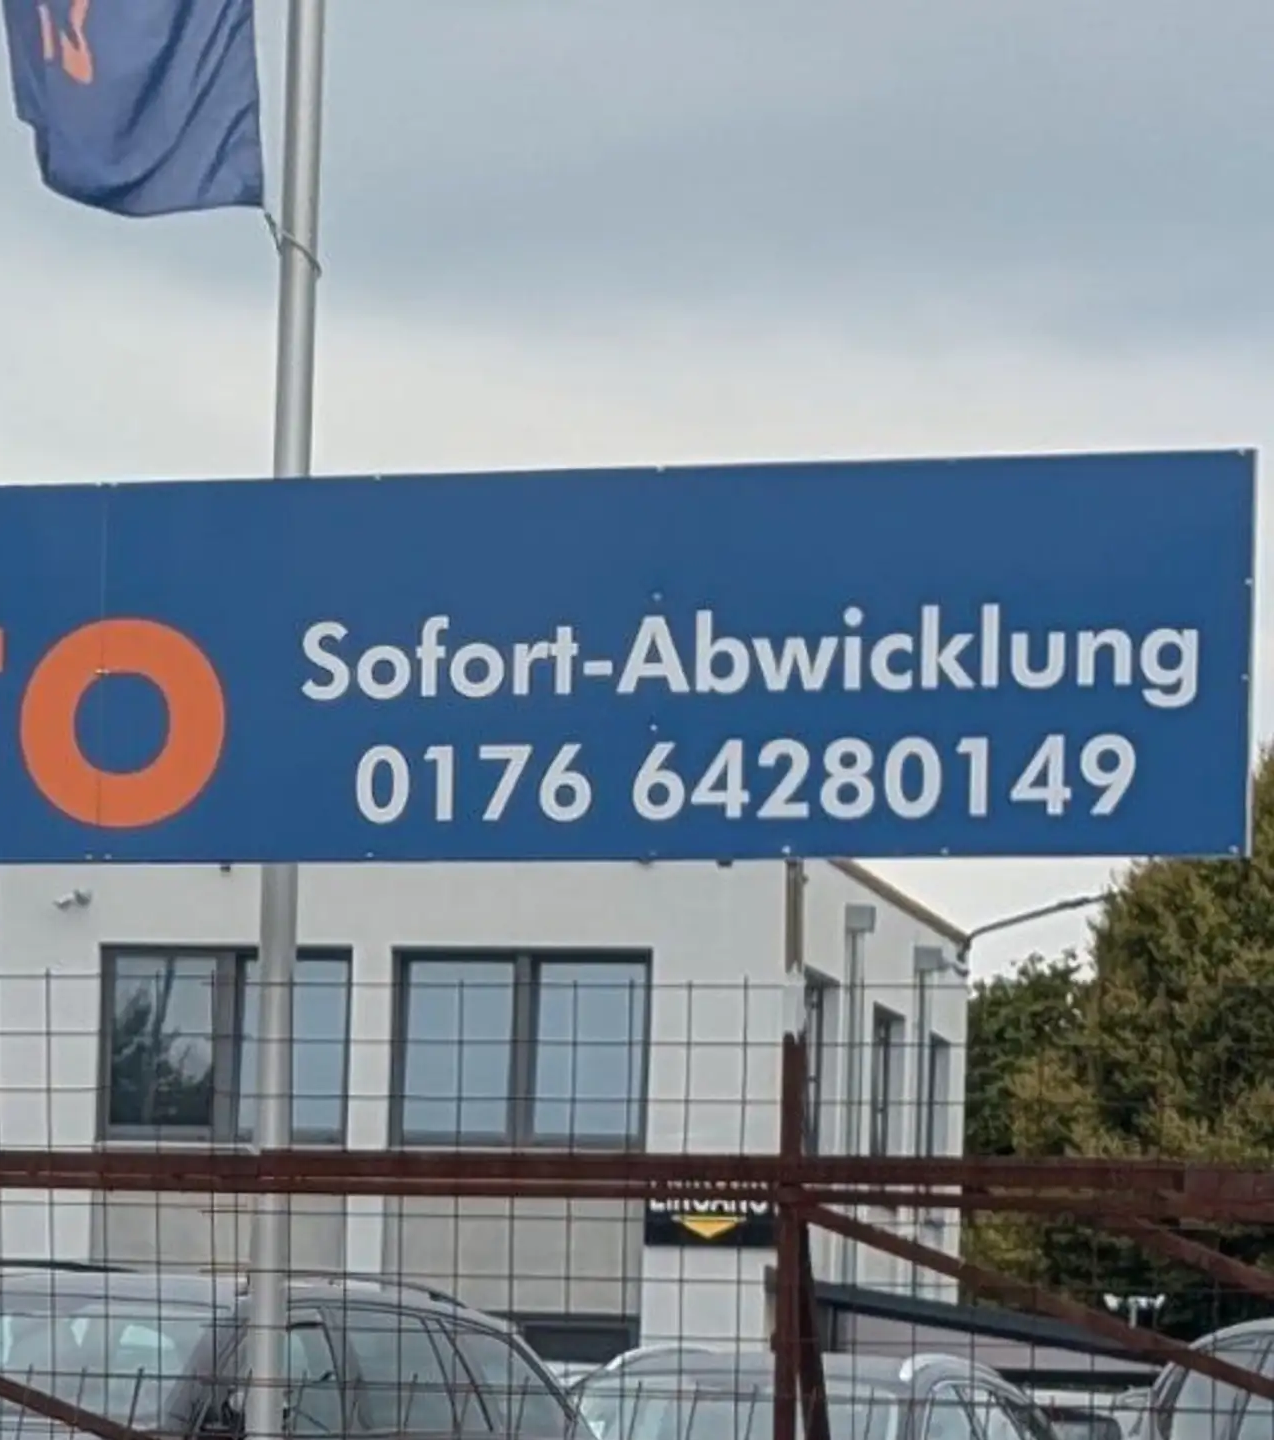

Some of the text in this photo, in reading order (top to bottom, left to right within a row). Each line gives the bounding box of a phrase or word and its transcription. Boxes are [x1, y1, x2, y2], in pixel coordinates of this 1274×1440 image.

[299, 605, 1201, 709] Sofort-Abwicklung
[354, 734, 1138, 824] 0176 64280149
